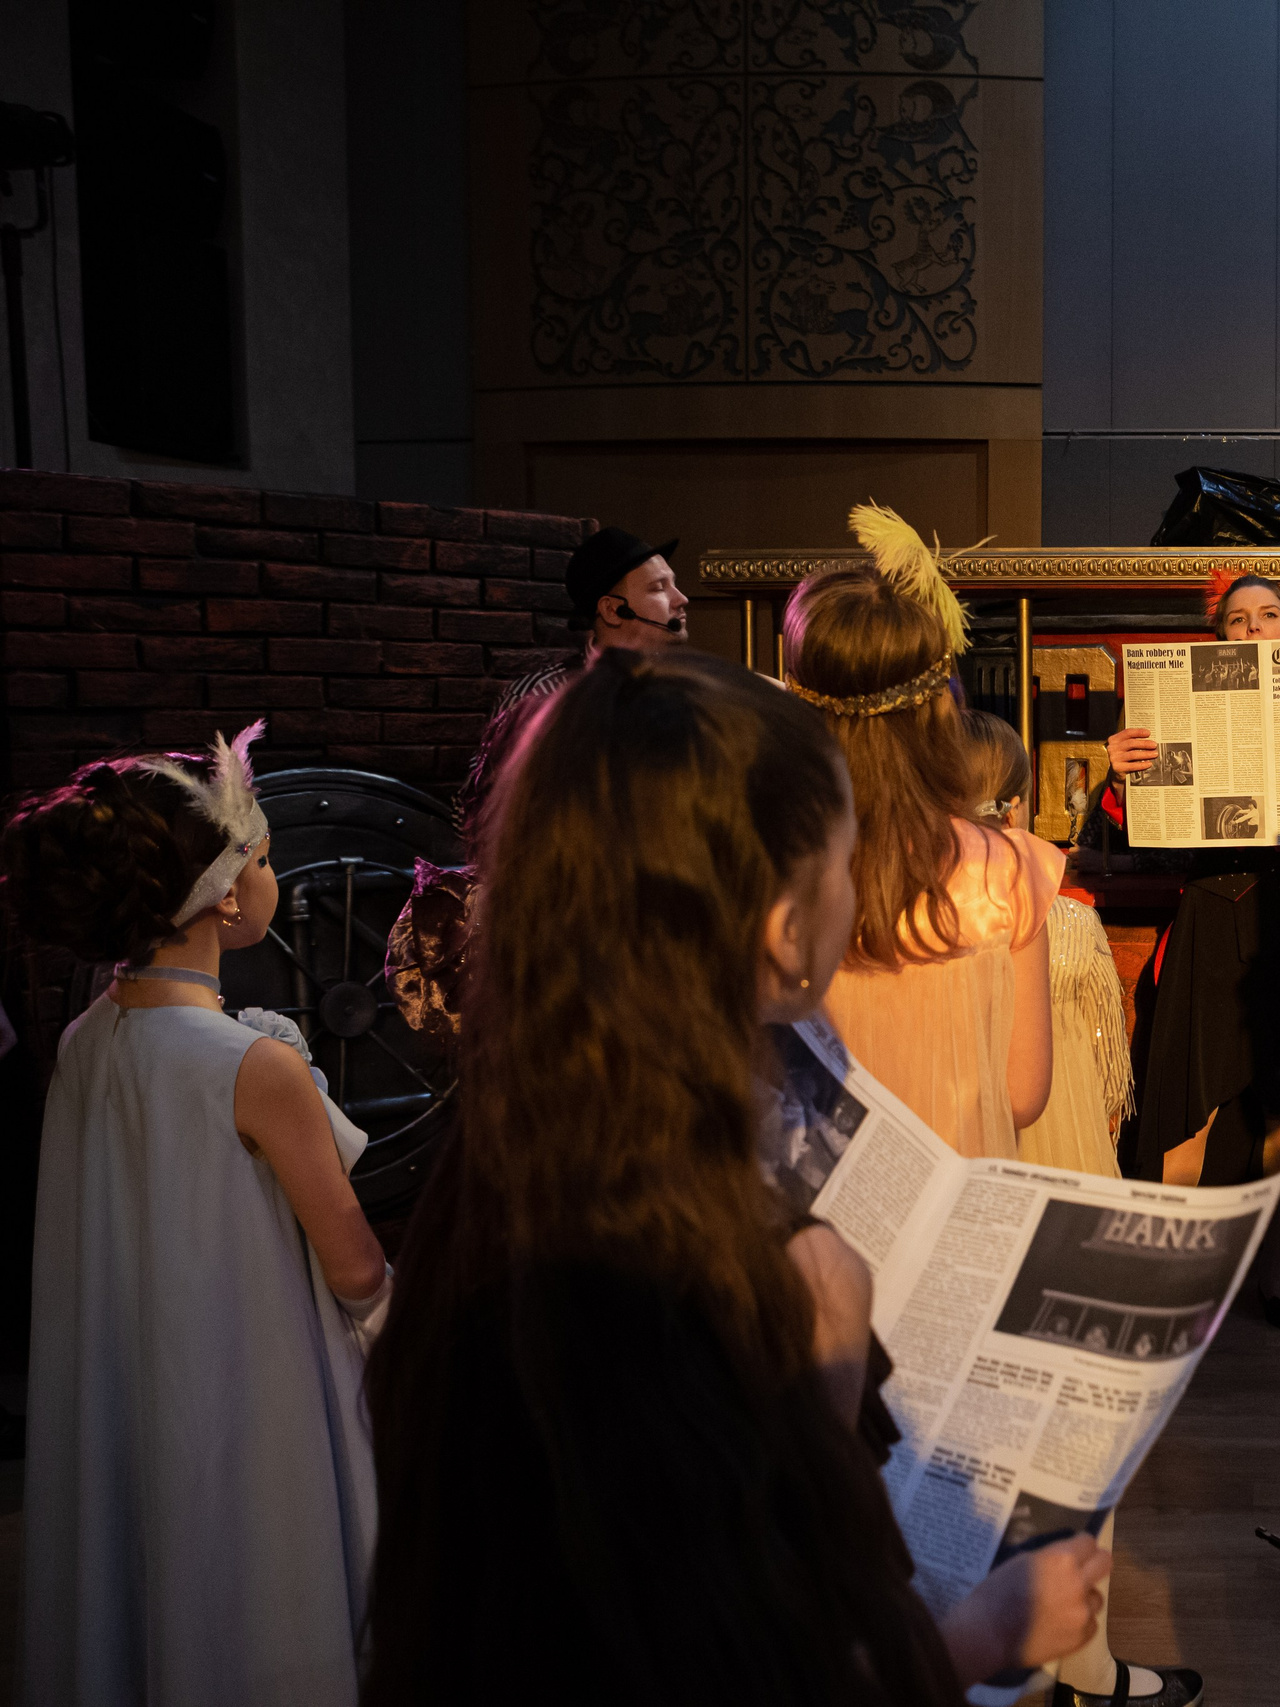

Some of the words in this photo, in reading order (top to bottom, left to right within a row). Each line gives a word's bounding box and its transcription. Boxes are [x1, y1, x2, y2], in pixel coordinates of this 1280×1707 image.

[1127, 649, 1144, 657] Bank
[1146, 648, 1174, 658] robbery
[1176, 649, 1186, 657] on
[1127, 660, 1167, 670] Magnificent
[1169, 660, 1184, 669] Mile
[1104, 1211, 1216, 1250] BANK
